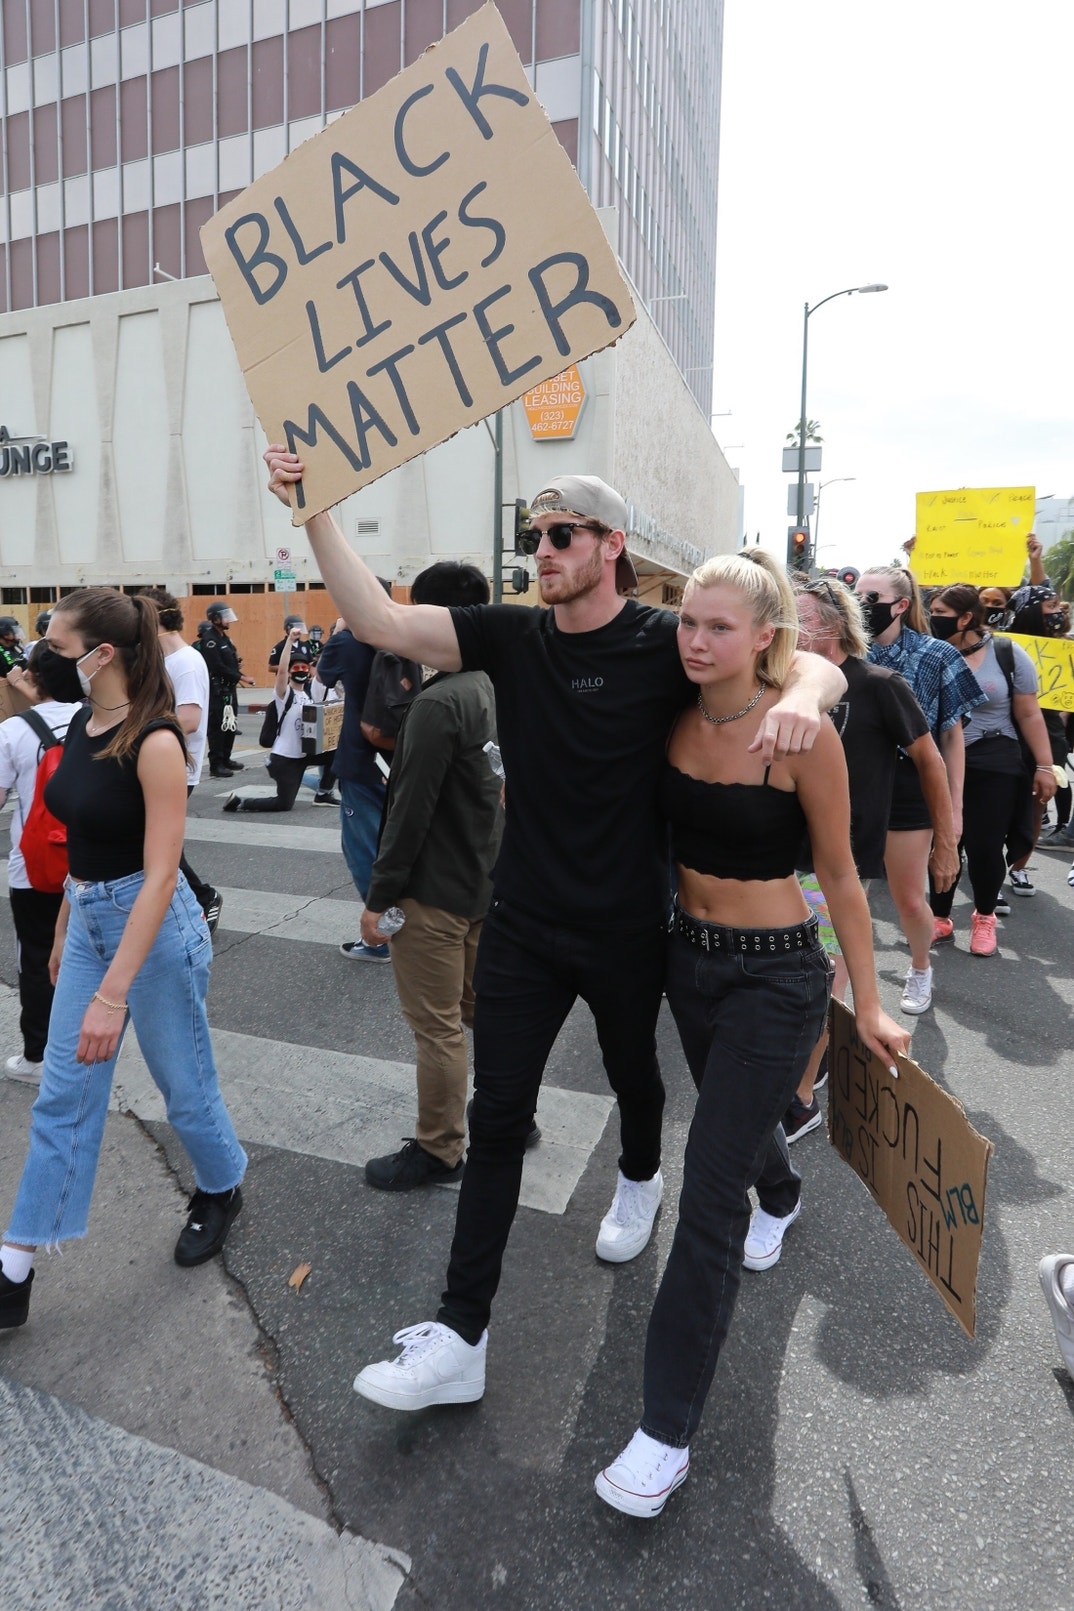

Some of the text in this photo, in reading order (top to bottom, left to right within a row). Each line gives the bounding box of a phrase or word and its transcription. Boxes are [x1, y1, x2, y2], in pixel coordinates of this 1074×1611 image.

[224, 42, 531, 306] BLACK
[306, 181, 507, 374] LIVES
[283, 251, 622, 509] MATTER
[525, 392, 581, 407] LEASING
[531, 421, 575, 432] 462-6727
[540, 410, 565, 421] (323)
[571, 676, 604, 689] HALO
[836, 1045, 942, 1202] FUCKED
[858, 1124, 962, 1304] THIS IS
[938, 1182, 979, 1230] BLM
